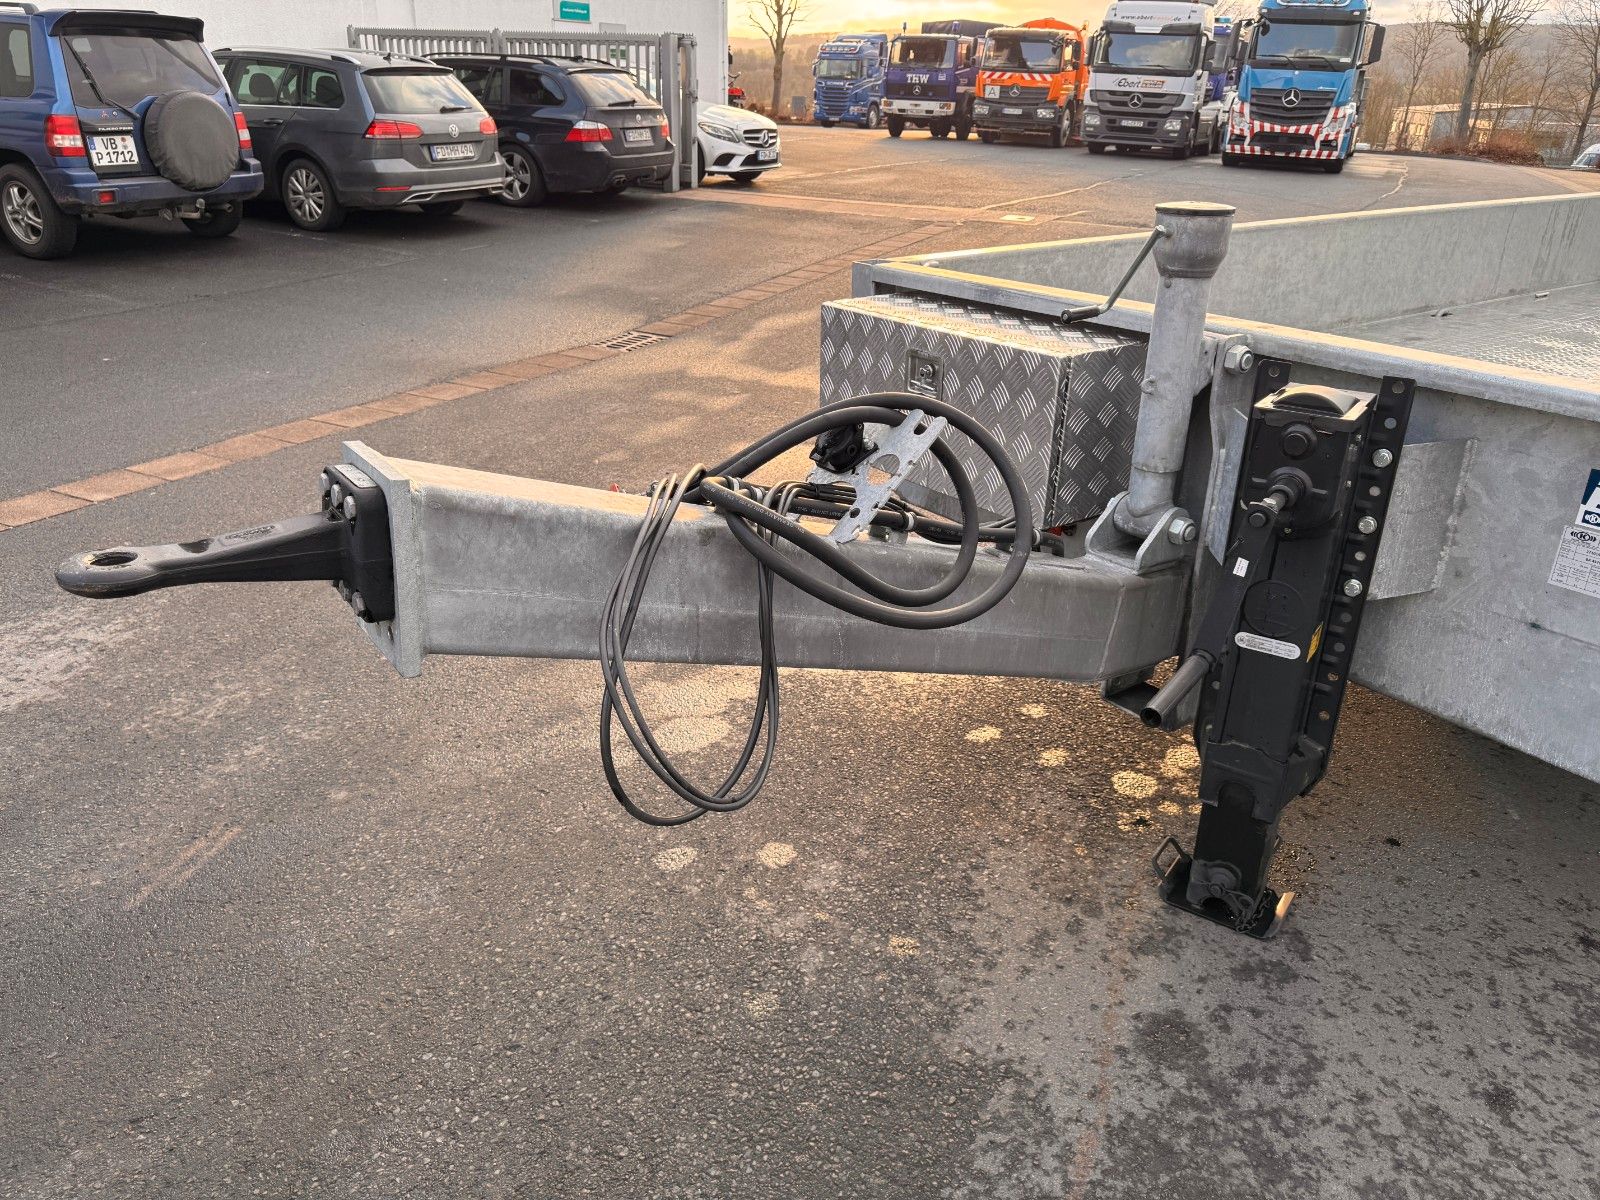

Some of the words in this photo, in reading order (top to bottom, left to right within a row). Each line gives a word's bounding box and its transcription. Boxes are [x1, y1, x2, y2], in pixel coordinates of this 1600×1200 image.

[906, 74, 929, 83] THW
[1117, 78, 1142, 88] Ebert
[987, 86, 996, 97] A
[101, 137, 118, 150] VB
[95, 152, 104, 164] P
[106, 150, 136, 164] 1712
